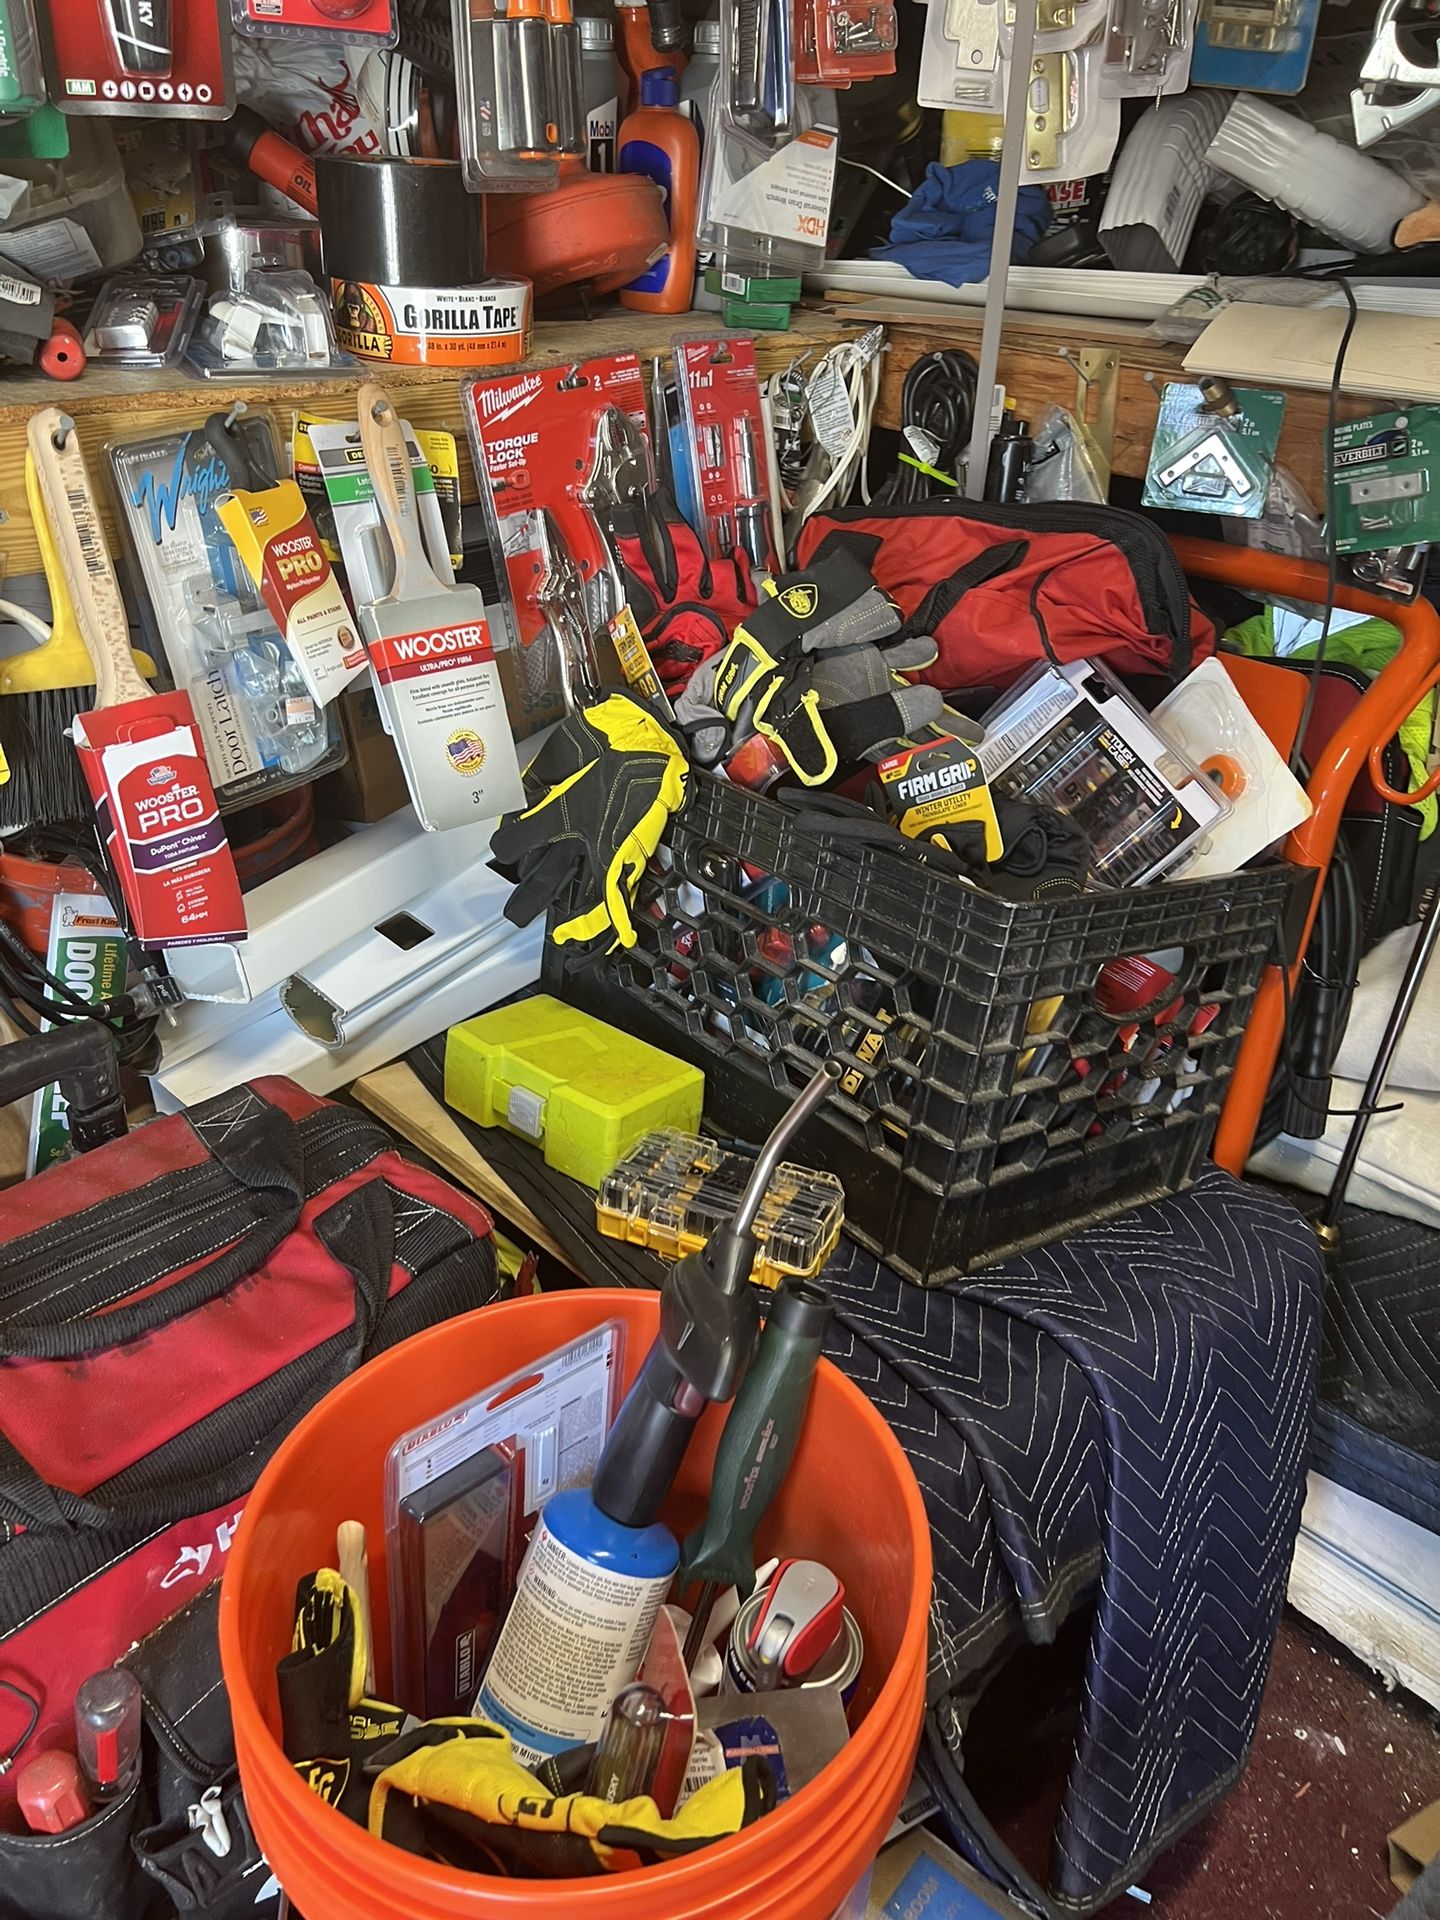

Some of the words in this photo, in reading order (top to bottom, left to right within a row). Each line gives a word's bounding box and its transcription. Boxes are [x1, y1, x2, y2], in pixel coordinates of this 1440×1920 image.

[590, 121, 614, 137] Mobil
[797, 214, 827, 238] HDX
[404, 304, 480, 330] GORILLA
[483, 305, 516, 329] TAPE
[594, 375, 600, 387] 2
[477, 374, 543, 418] Milwaukee
[1244, 418, 1250, 427] 2
[485, 432, 539, 453] TORQUE
[1411, 439, 1417, 448] 2
[489, 448, 524, 465] LOCK
[1334, 446, 1384, 464] EVERBILT
[132, 432, 230, 545] Wright
[271, 535, 314, 558] WOOSTER
[275, 550, 323, 581] PRO
[297, 616, 306, 625] ALL
[393, 625, 484, 660] WOOSTER
[456, 655, 473, 665] FIRM
[206, 669, 233, 725] Latch
[225, 730, 247, 776] Door
[1110, 733, 1137, 764] TOUGH
[898, 771, 938, 800] FIRM
[938, 758, 977, 788] GRIP
[135, 785, 199, 812] WOOSTER
[915, 801, 943, 815] WINTER
[943, 792, 972, 807] UTILITY
[138, 798, 204, 834] PRO
[76, 914, 101, 926] Frost
[181, 911, 208, 924] 64MM
[103, 942, 118, 989] Lifetime
